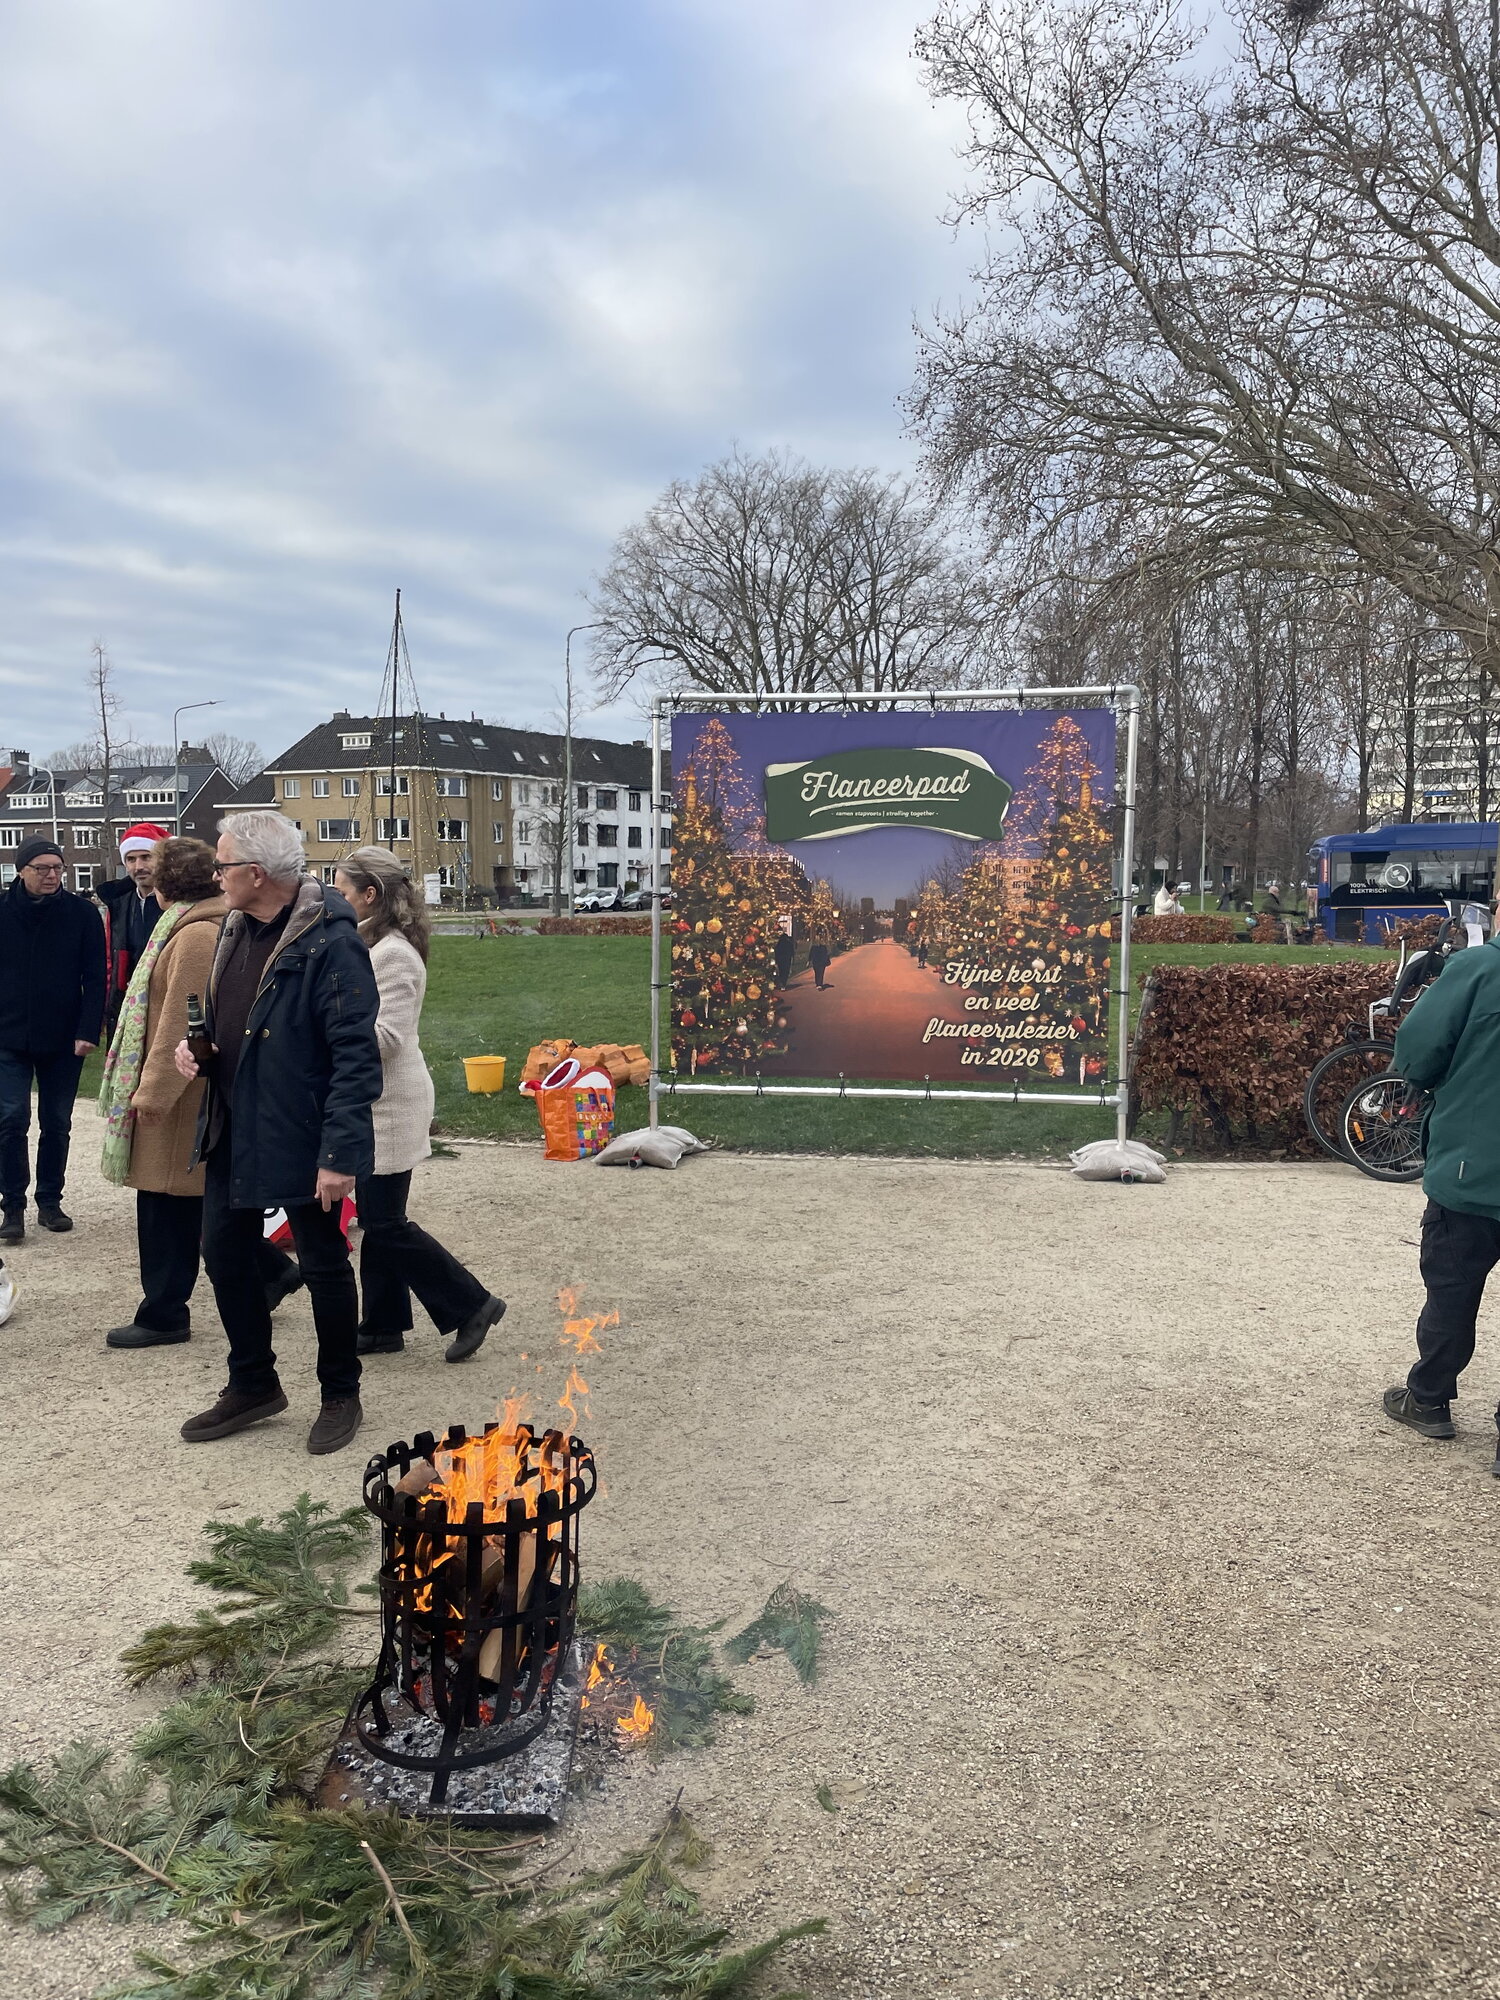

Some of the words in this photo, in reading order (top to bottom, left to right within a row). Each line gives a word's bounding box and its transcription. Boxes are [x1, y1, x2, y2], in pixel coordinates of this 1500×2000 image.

[800, 769, 971, 802] Flaneerpad
[910, 810, 935, 818] together
[944, 961, 1003, 990] Fijne
[1005, 964, 1063, 984] kerst
[964, 996, 992, 1010] en
[994, 993, 1041, 1011] veel
[922, 1017, 1080, 1043] flaneerplezier
[960, 1047, 984, 1065] in
[986, 1048, 1041, 1067] 2026
